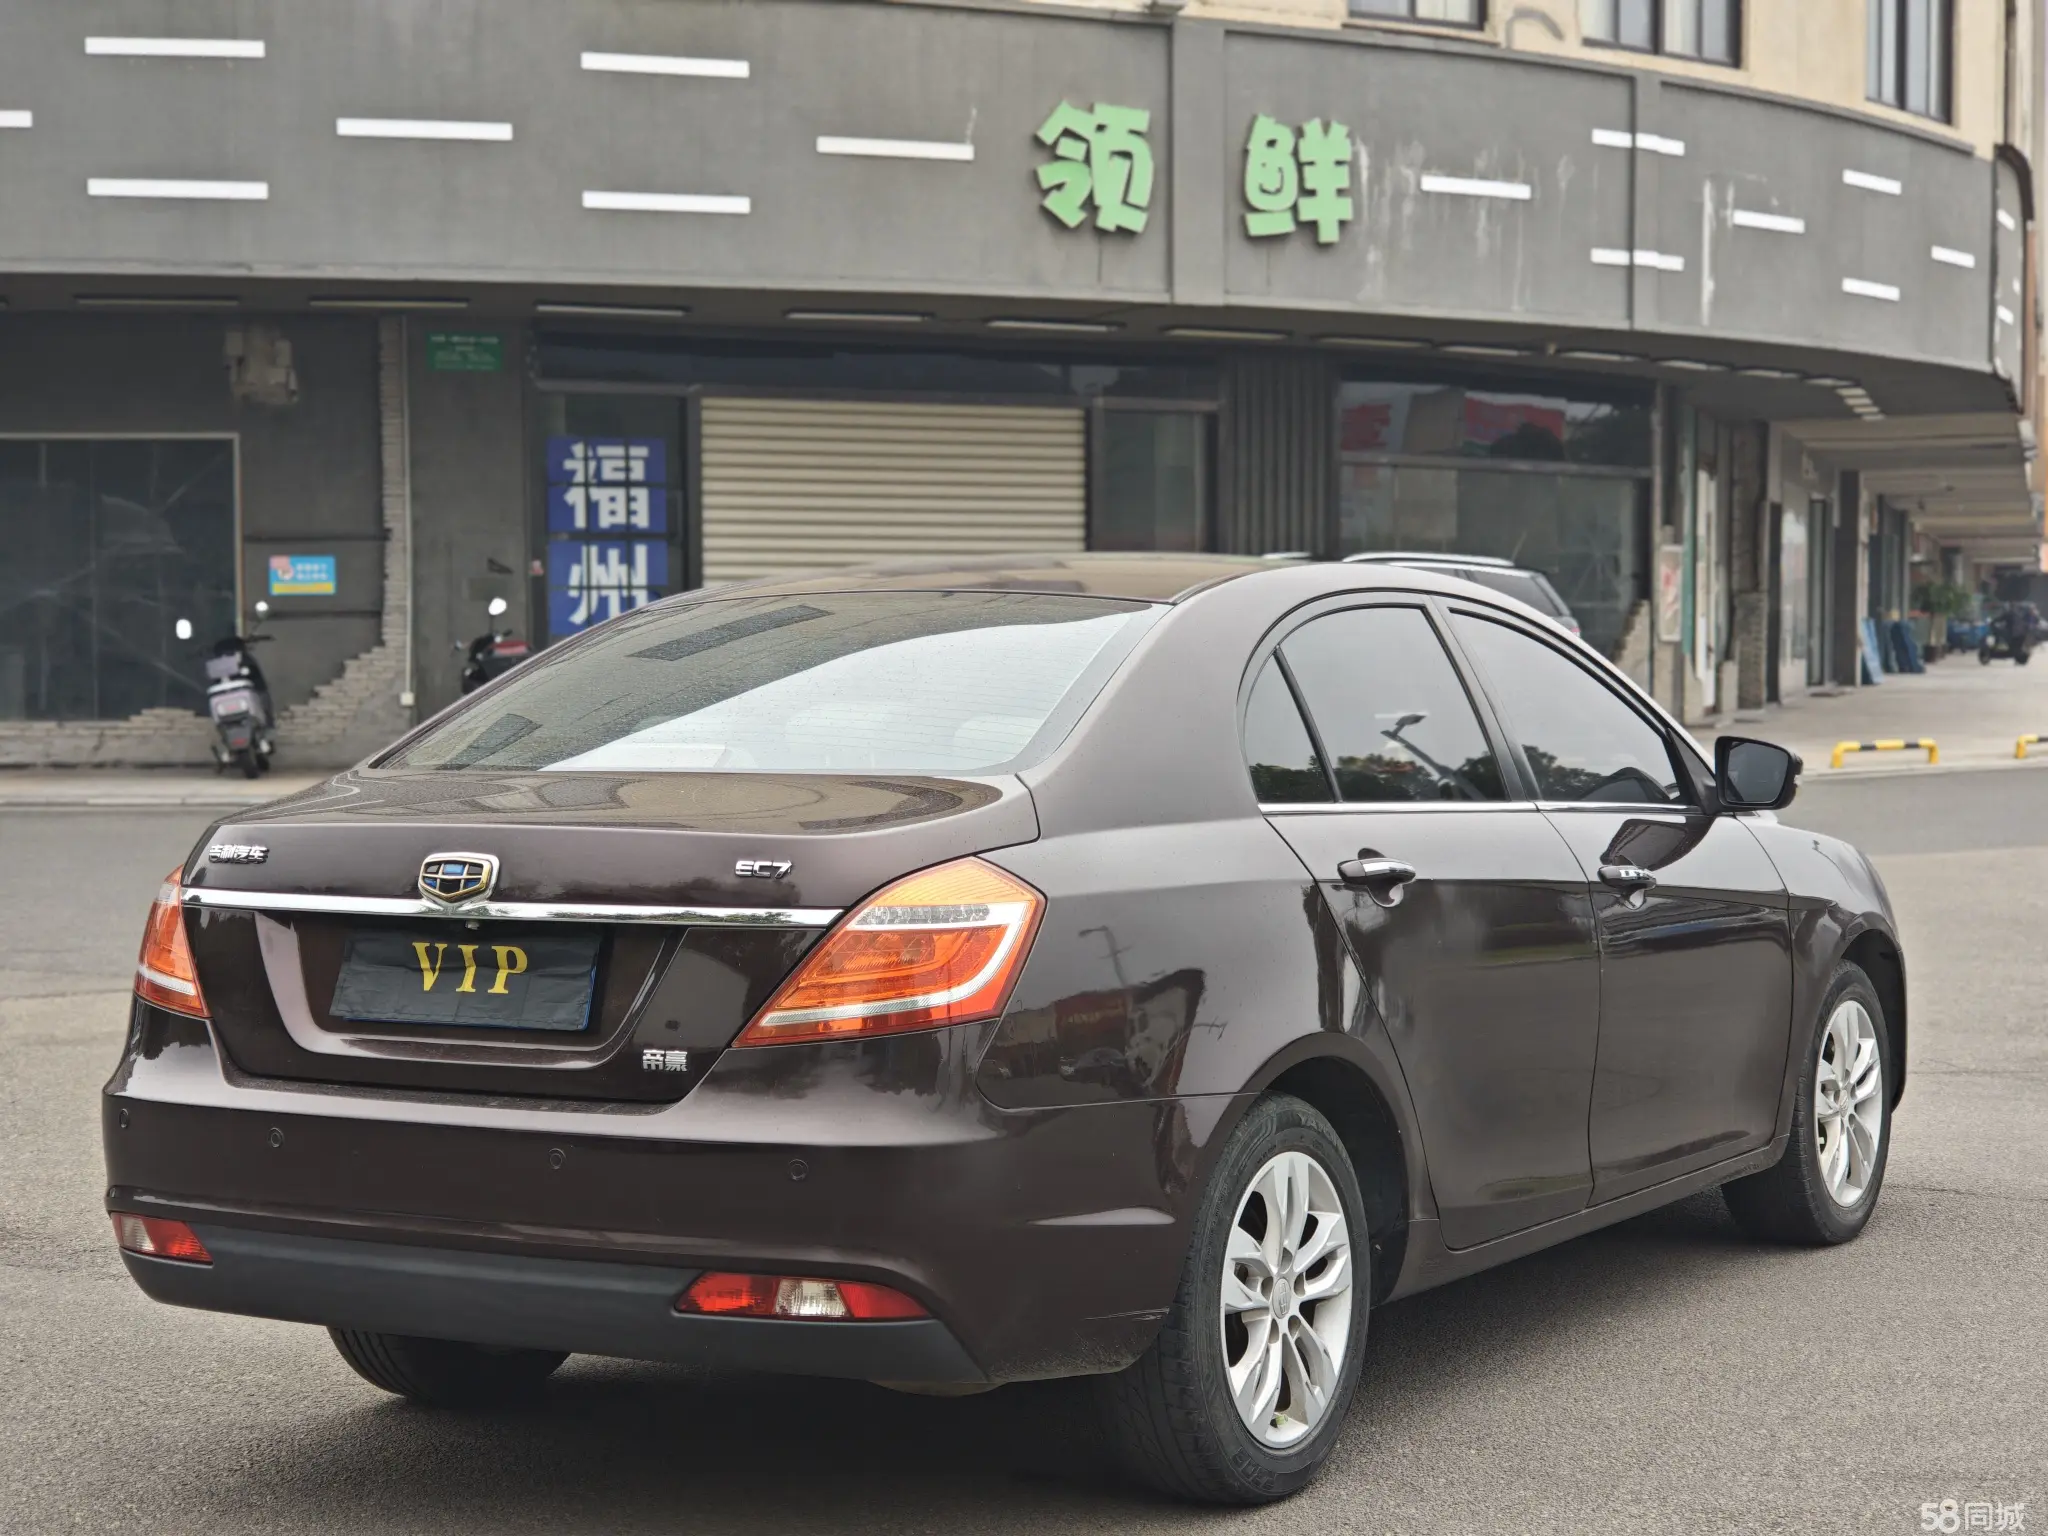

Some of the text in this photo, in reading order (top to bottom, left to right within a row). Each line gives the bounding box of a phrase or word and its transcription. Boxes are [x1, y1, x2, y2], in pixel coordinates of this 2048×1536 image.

[1034, 100, 1353, 243] 领鲜
[563, 441, 650, 625] 福州
[735, 860, 793, 879] EC7
[412, 942, 528, 994] VIP
[643, 1049, 688, 1072] 帝豪
